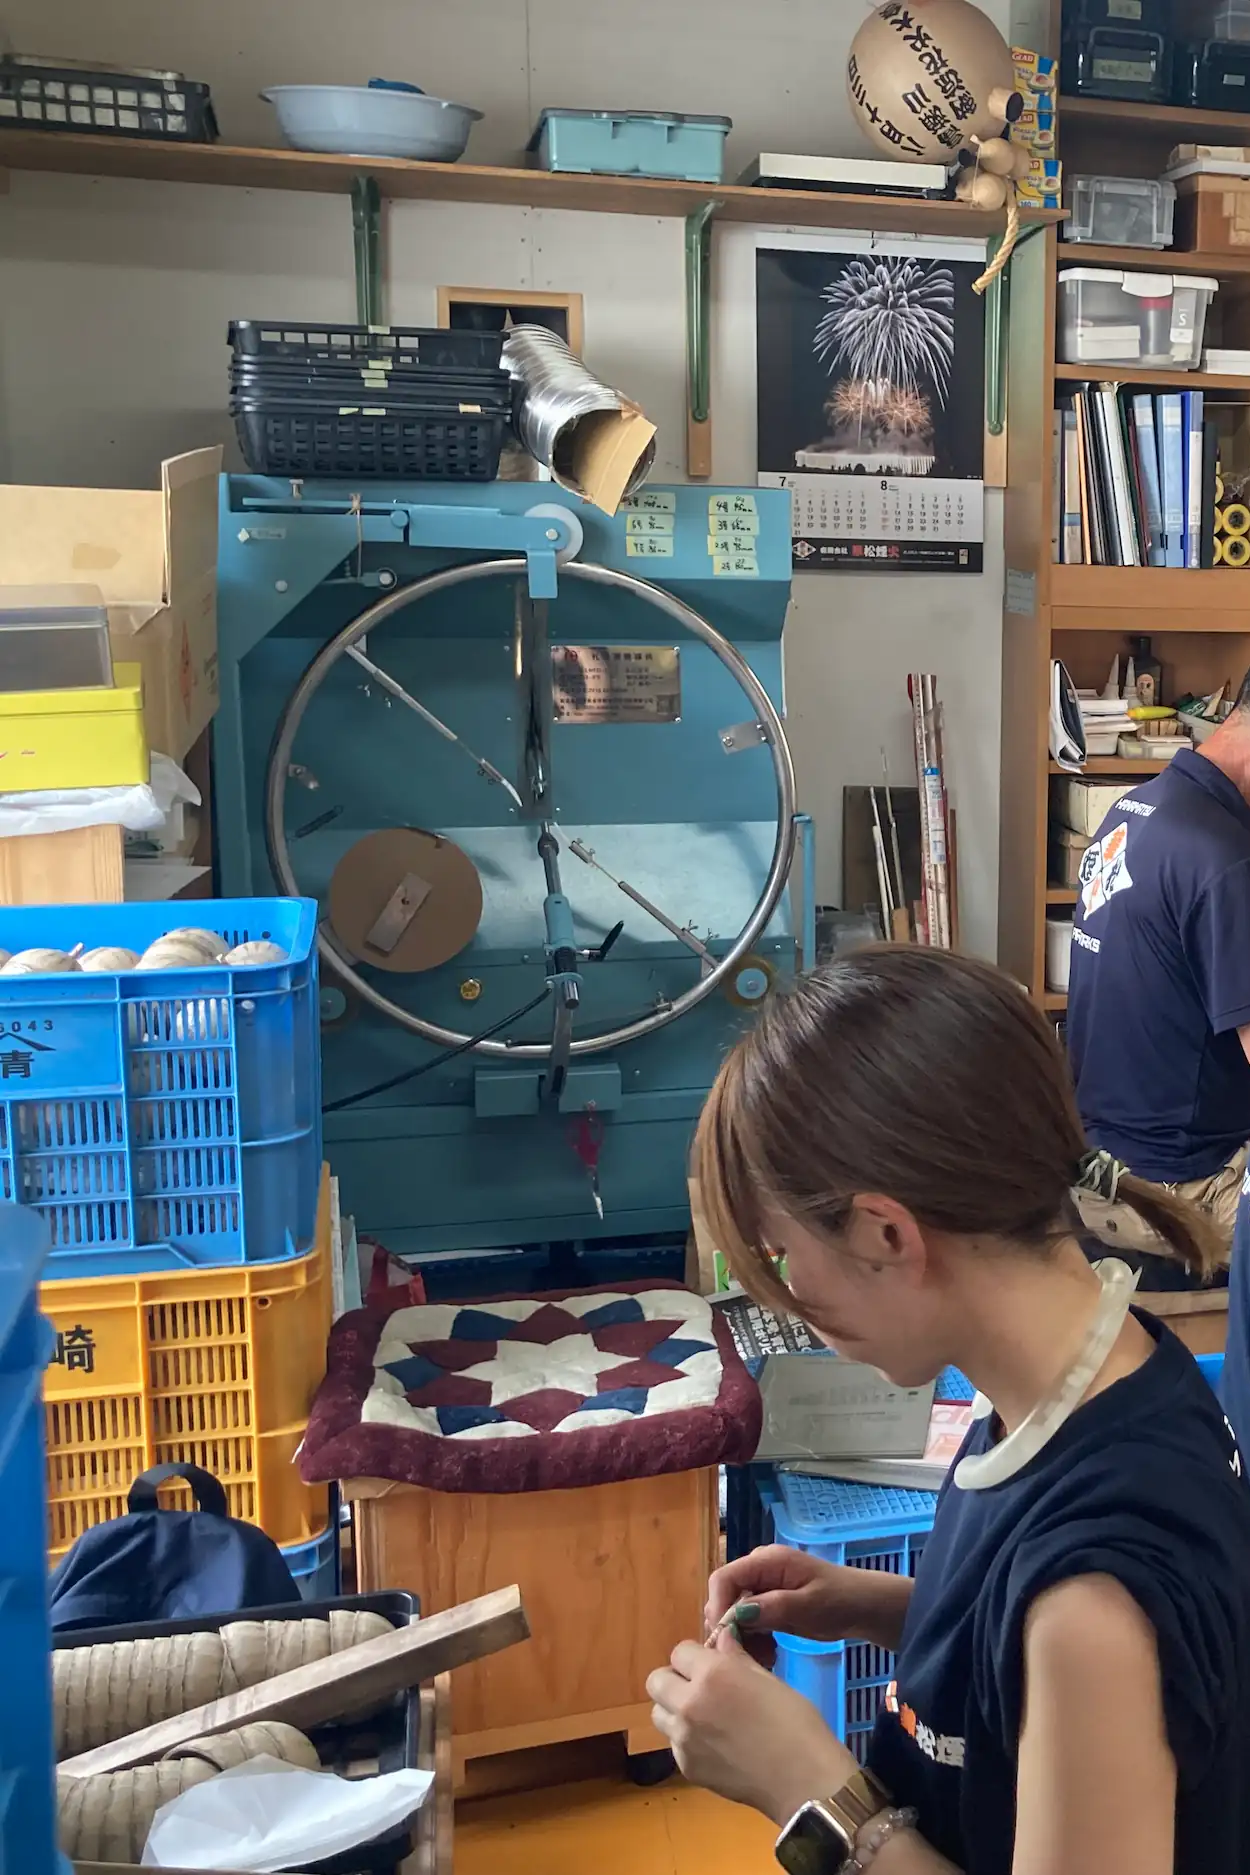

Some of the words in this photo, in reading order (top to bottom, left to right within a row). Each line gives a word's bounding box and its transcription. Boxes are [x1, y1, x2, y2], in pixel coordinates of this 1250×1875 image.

[902, 83, 965, 149] 高瀬川
[779, 476, 786, 487] 7
[880, 480, 888, 491] 8
[0, 1050, 35, 1079] 青
